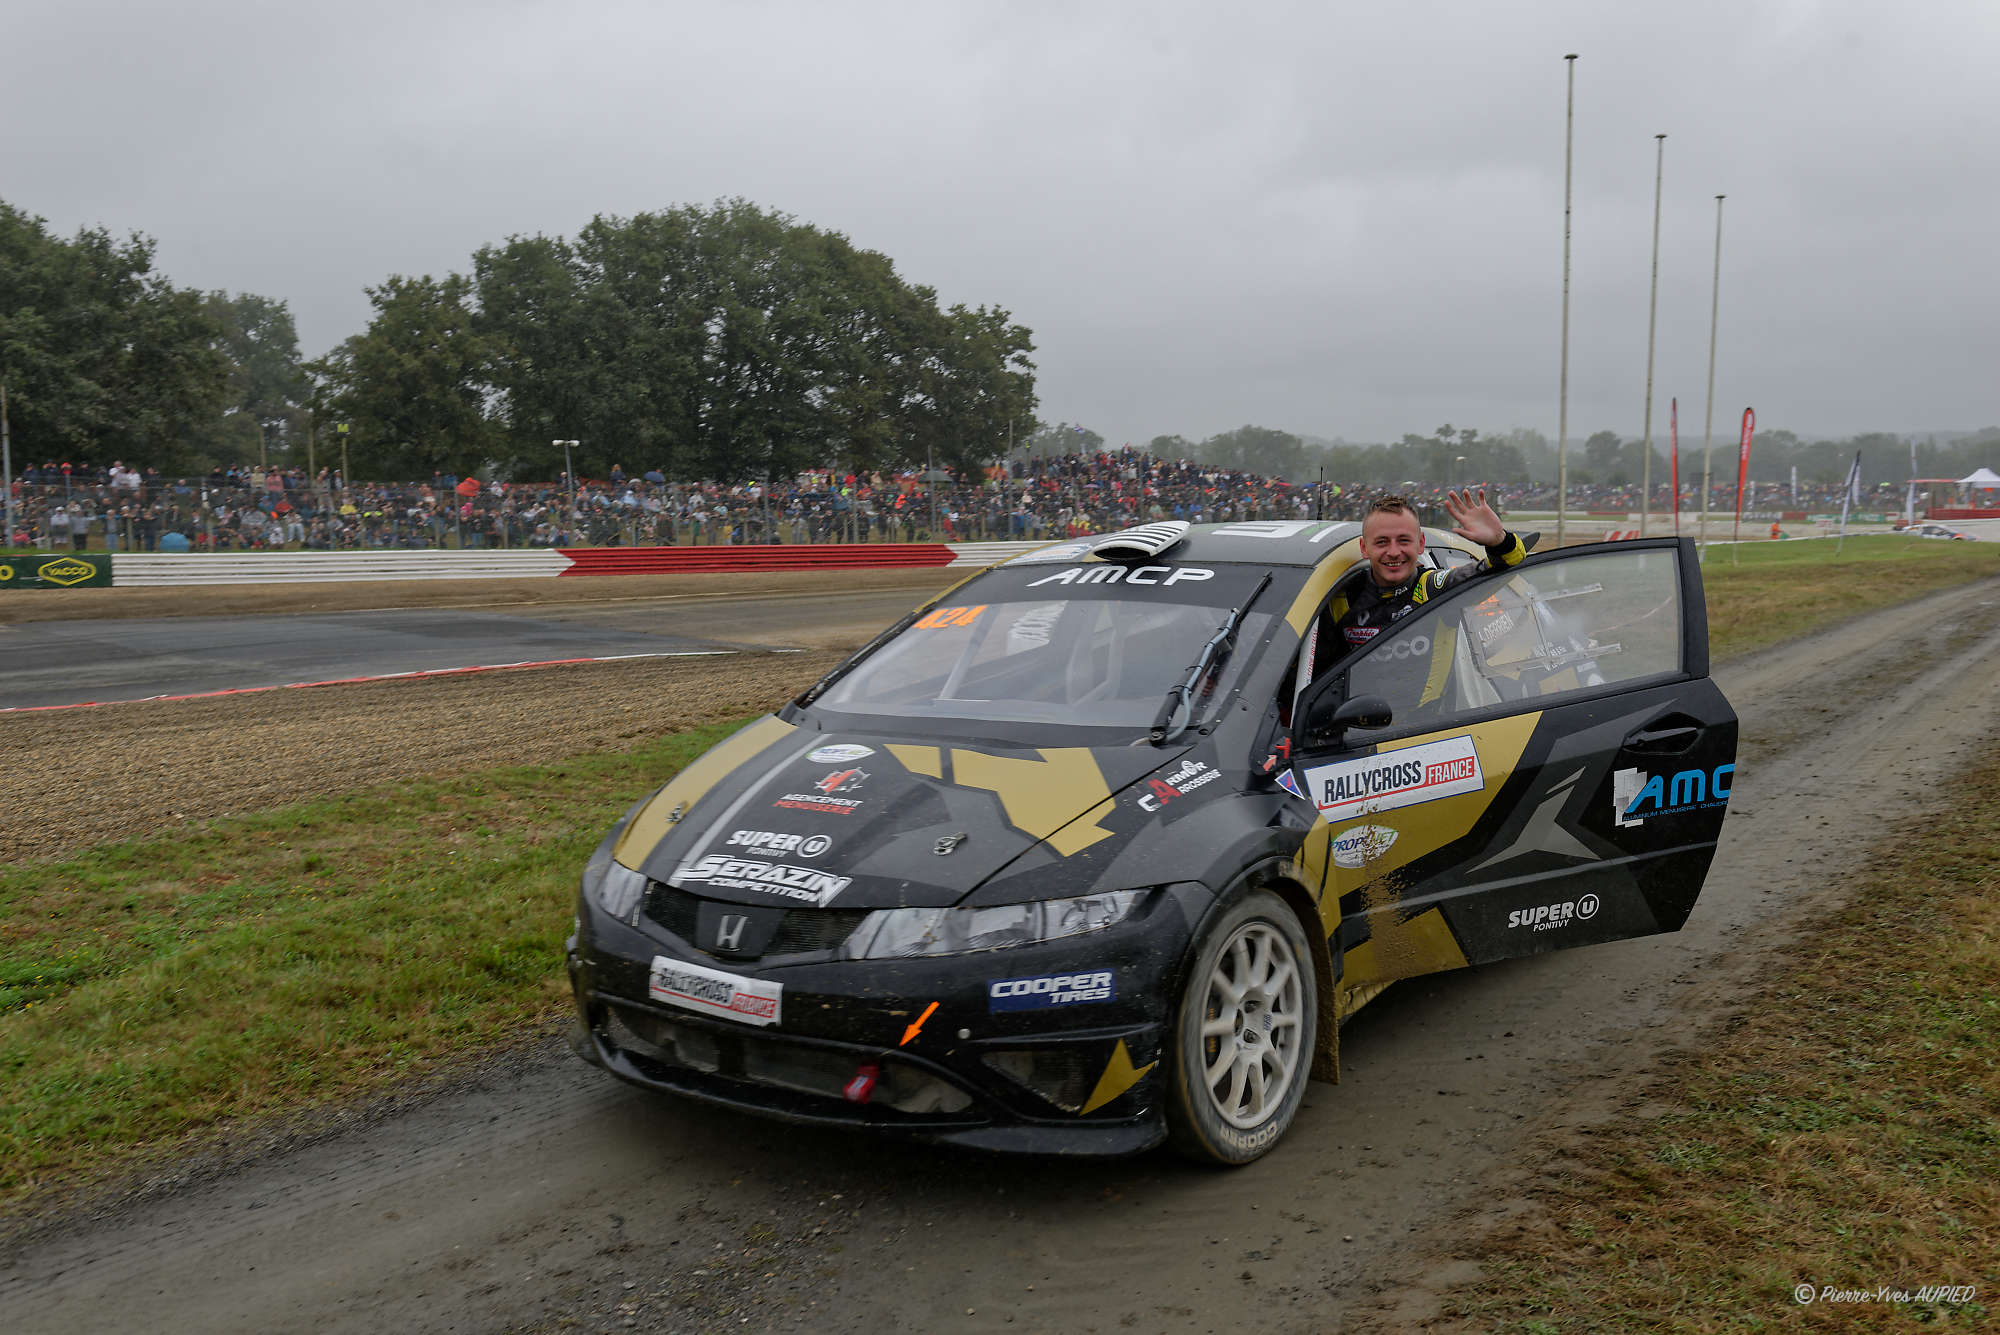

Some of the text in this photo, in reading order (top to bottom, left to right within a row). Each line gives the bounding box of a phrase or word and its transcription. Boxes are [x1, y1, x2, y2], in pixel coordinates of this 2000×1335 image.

[1026, 565, 1215, 587] AMCP
[1324, 758, 1473, 803] RALLYCROSS FRANCE
[726, 830, 803, 851] SUPER
[670, 854, 853, 908] SERAZIN
[707, 877, 822, 902] COMPETITION
[1508, 902, 1575, 928] SUPER
[1533, 919, 1570, 932] PONTIVY
[660, 968, 735, 1003] RALLYCROSS
[990, 972, 1113, 997] COOPER
[1048, 987, 1111, 1003] TIRES
